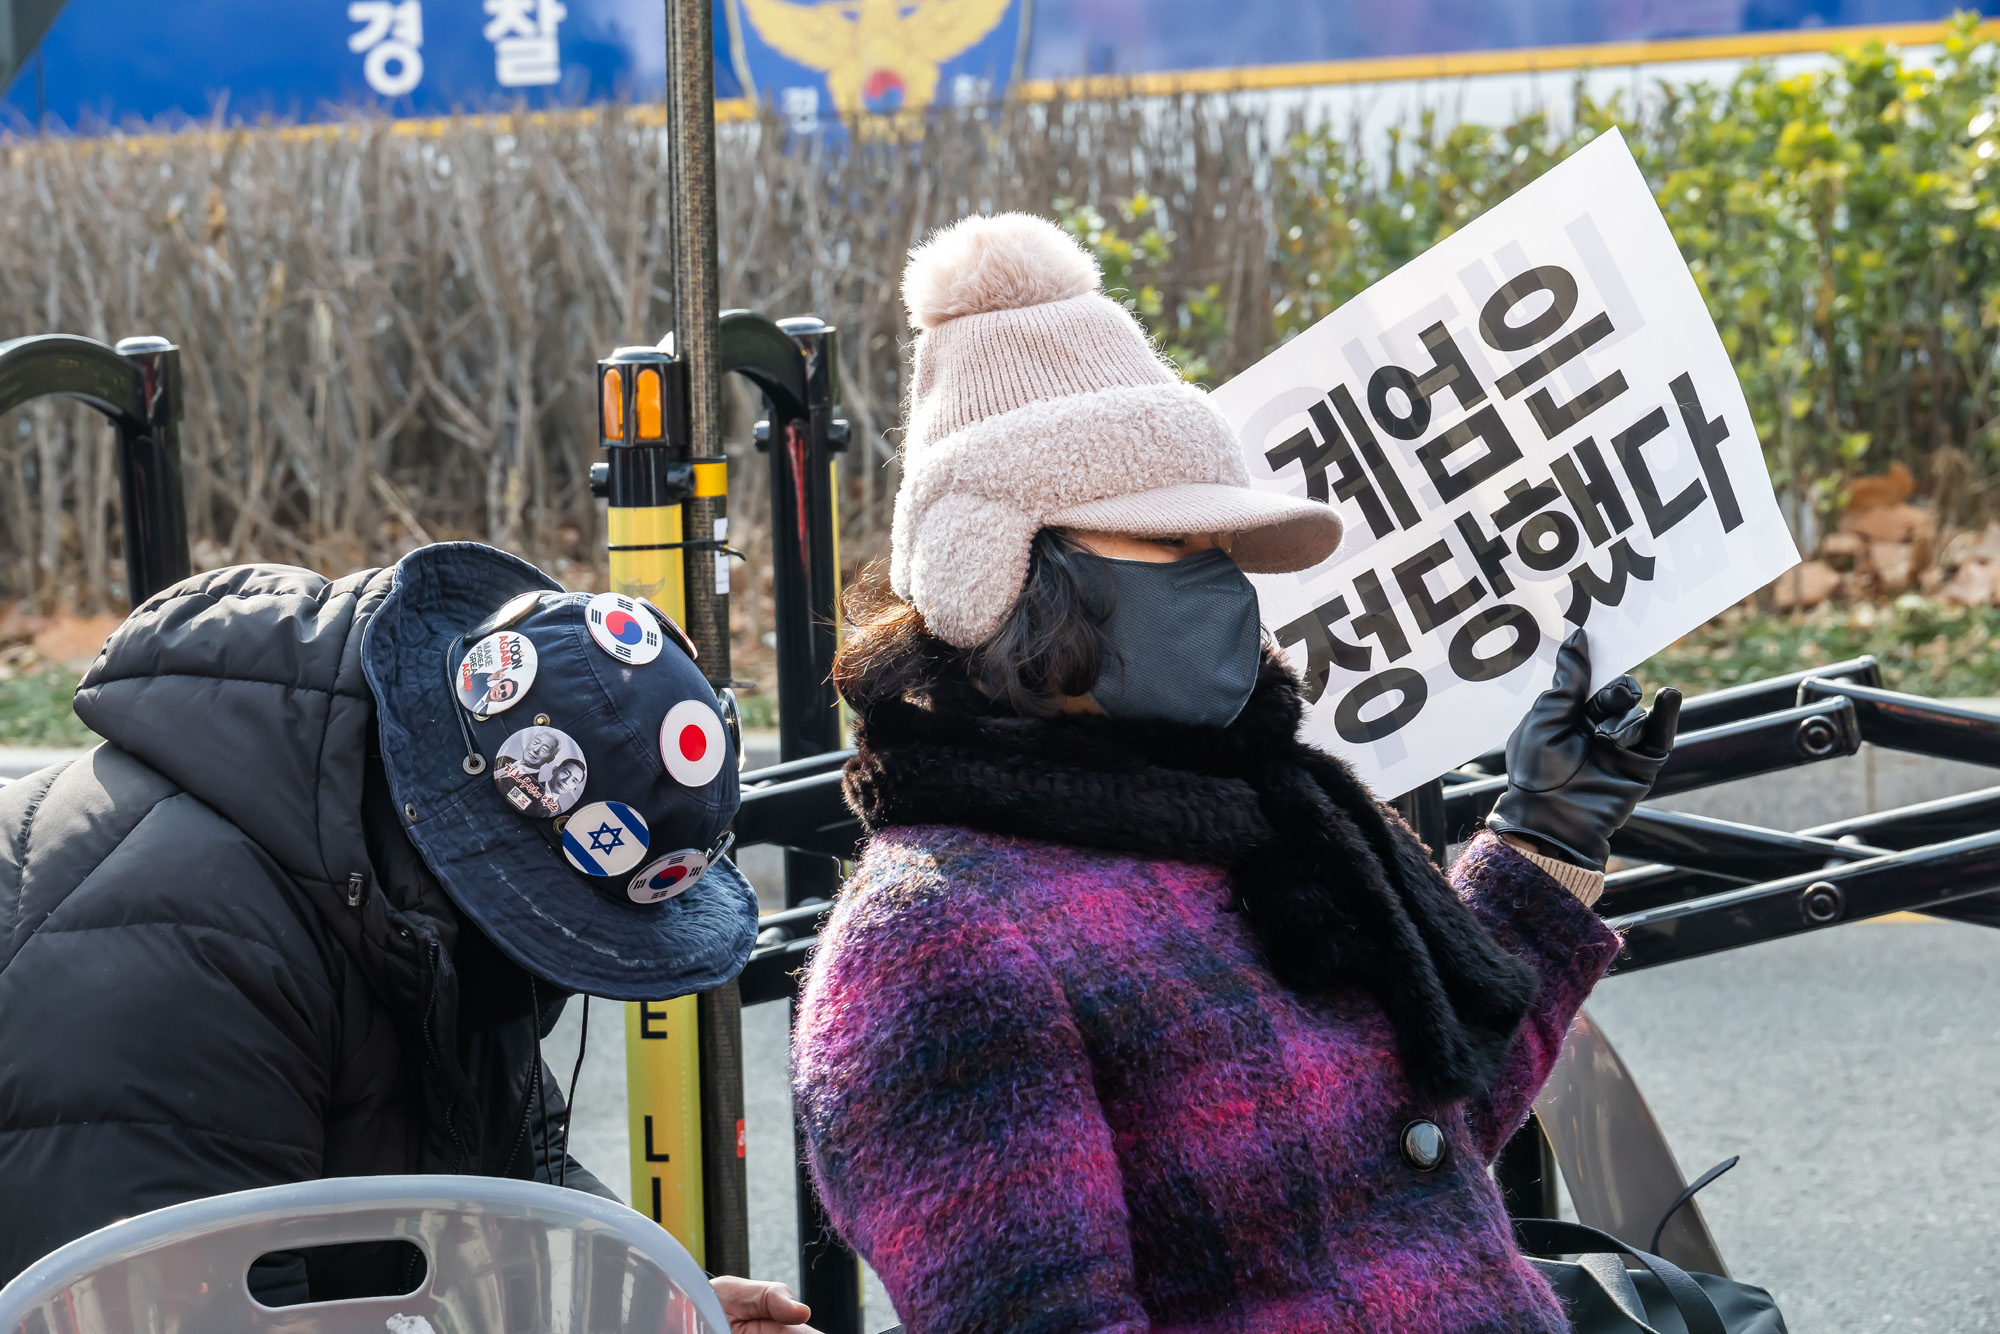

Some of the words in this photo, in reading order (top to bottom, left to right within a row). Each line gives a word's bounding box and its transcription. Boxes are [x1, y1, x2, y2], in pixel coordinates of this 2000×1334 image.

[347, 0, 567, 96] 경찰
[1264, 265, 1630, 540] 계엄은
[1274, 371, 1745, 744] 정당했다
[468, 652, 479, 675] GREA
[476, 645, 485, 669] KOREA
[483, 641, 494, 667] MAKE
[498, 635, 511, 668] AGAIN
[508, 636, 523, 670] YOON
[461, 663, 473, 693] AGAIN
